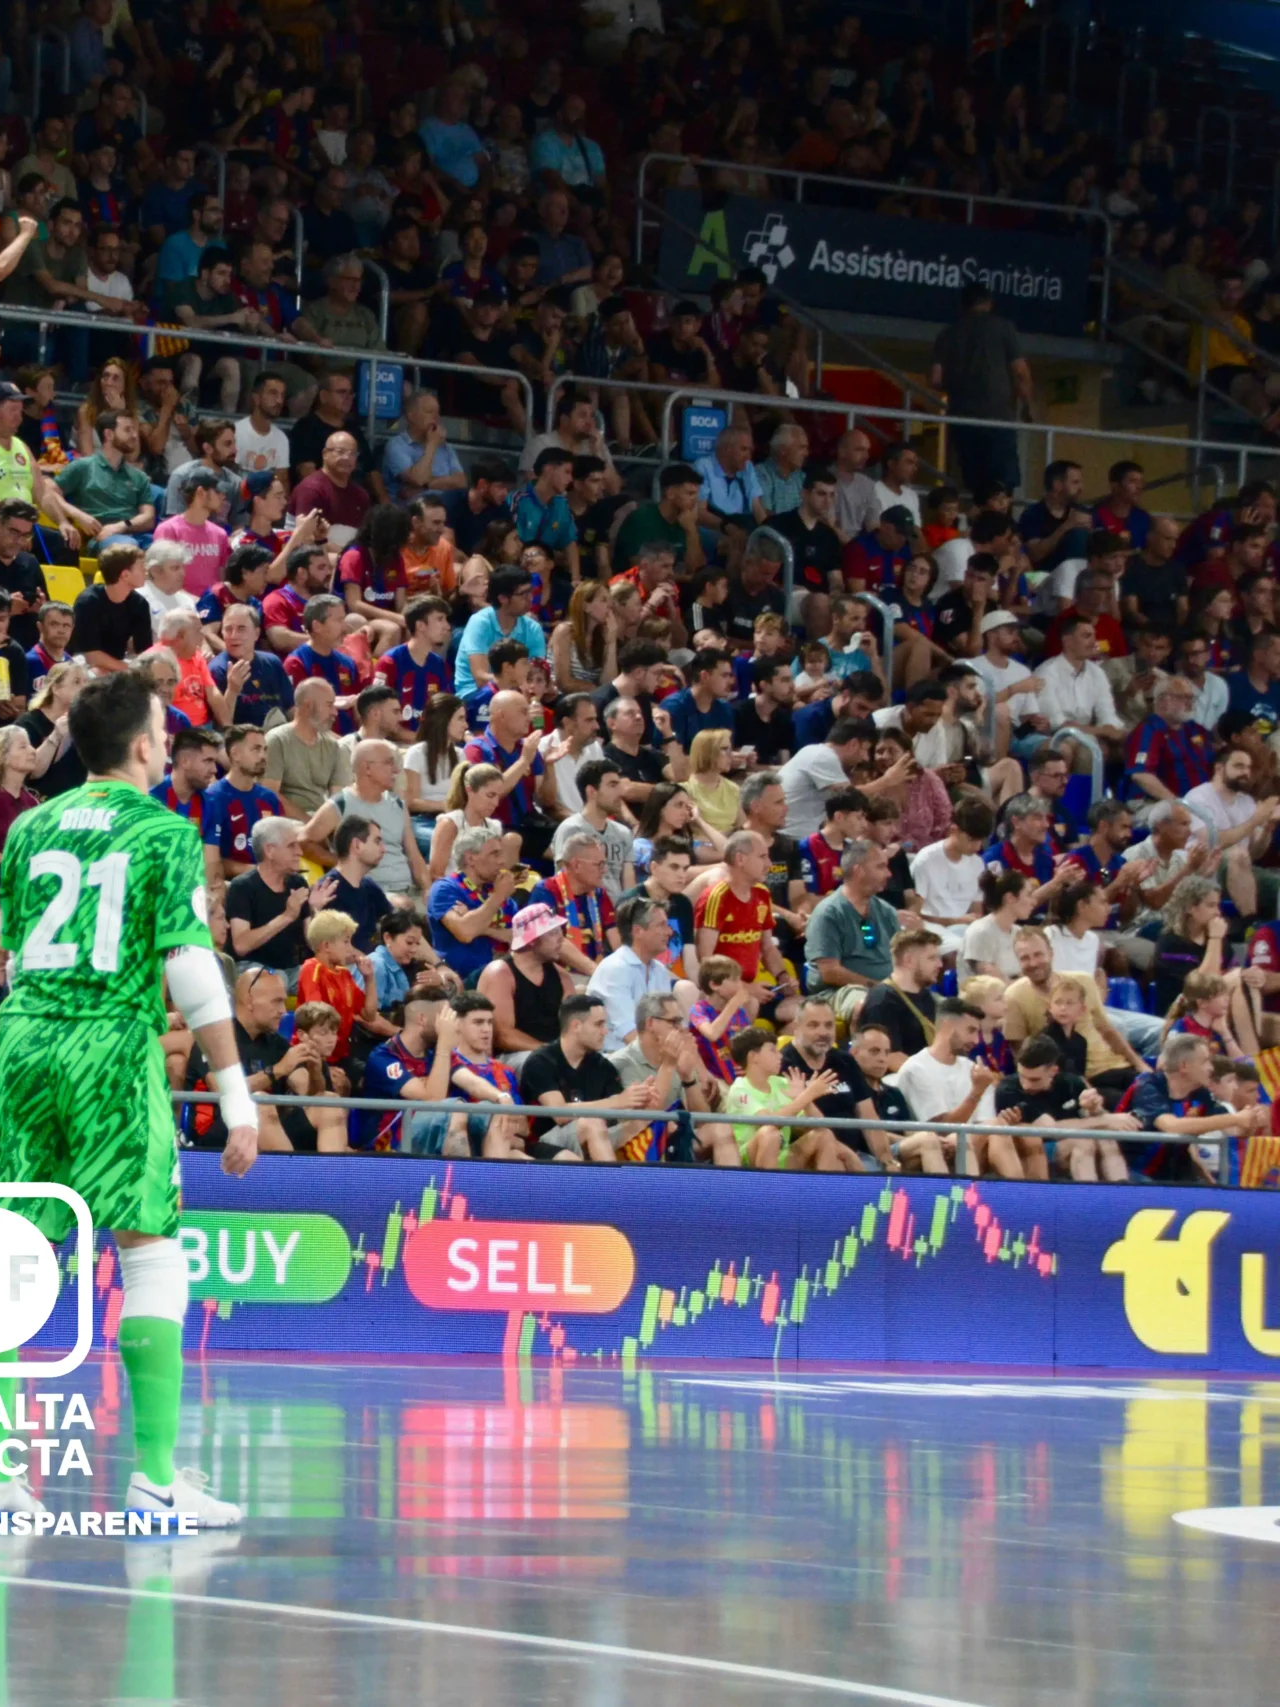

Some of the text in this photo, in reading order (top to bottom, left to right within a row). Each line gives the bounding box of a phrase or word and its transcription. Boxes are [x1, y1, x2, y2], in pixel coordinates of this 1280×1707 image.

[690, 415, 718, 429] BOCA
[59, 808, 117, 831] DIDAC
[22, 850, 131, 972] 21
[180, 1227, 301, 1285] BUY
[446, 1238, 593, 1295] SELL
